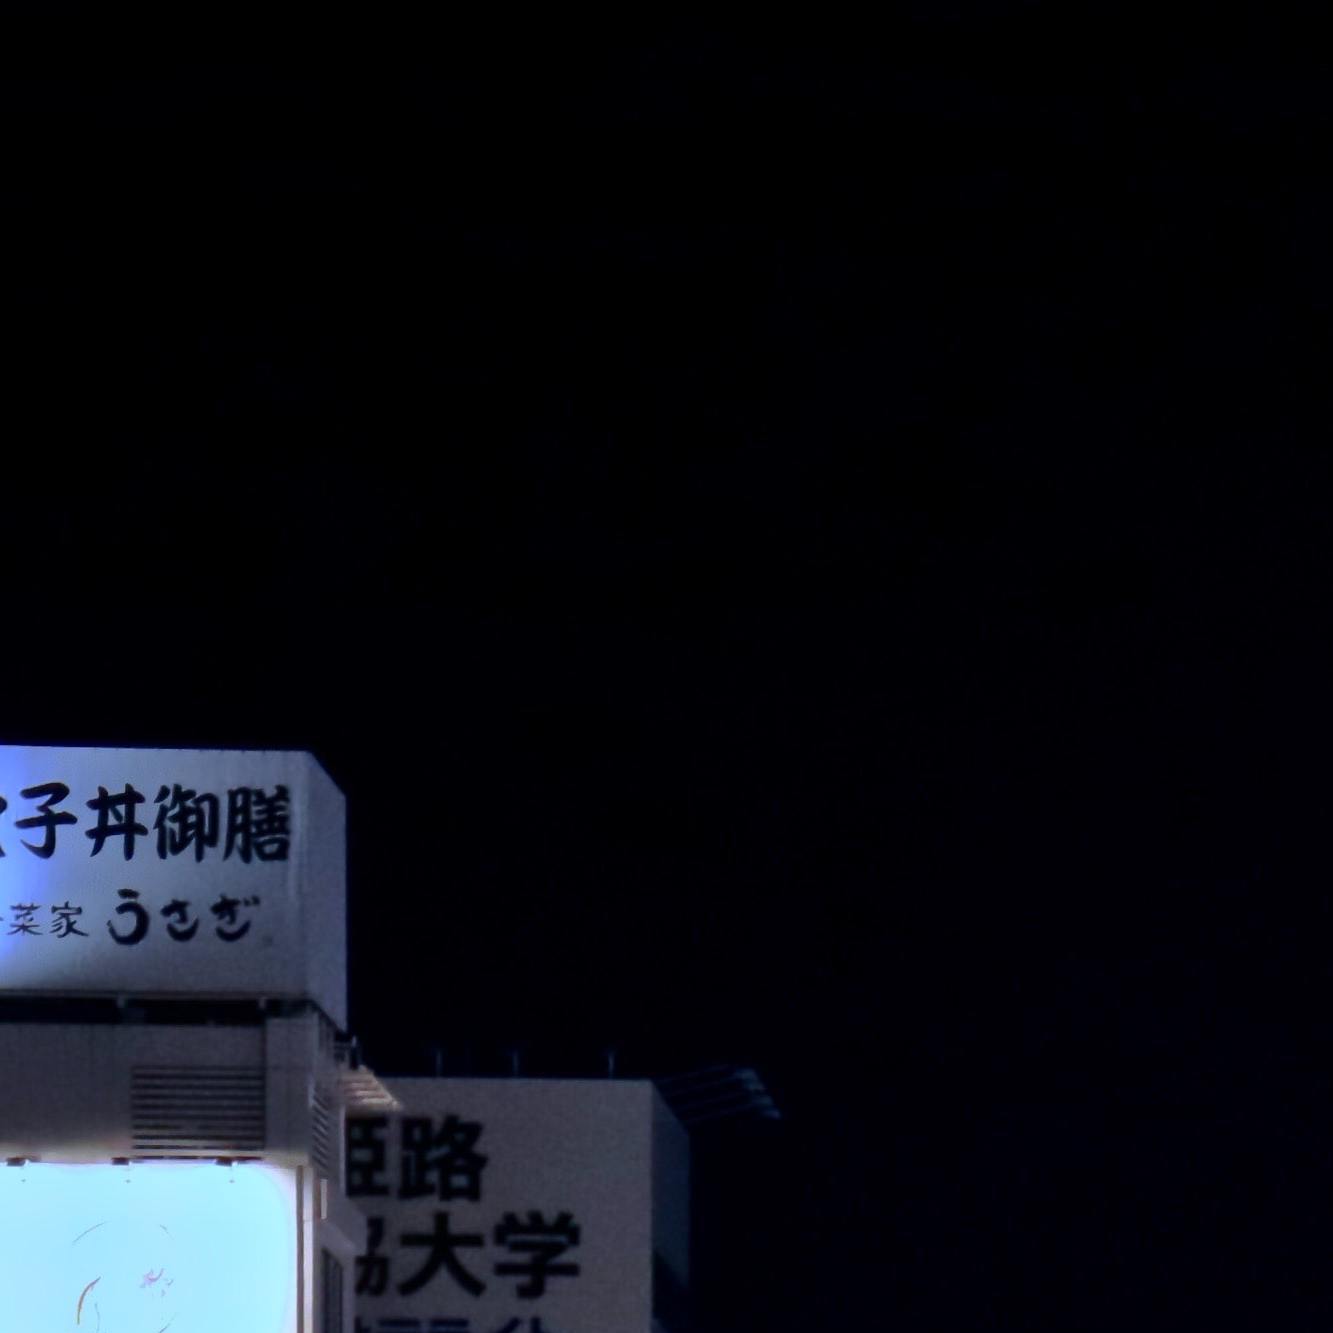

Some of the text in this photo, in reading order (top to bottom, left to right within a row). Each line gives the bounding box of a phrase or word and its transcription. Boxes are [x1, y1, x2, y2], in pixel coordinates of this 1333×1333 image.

[0, 888, 260, 946] 菜家 うさぎ
